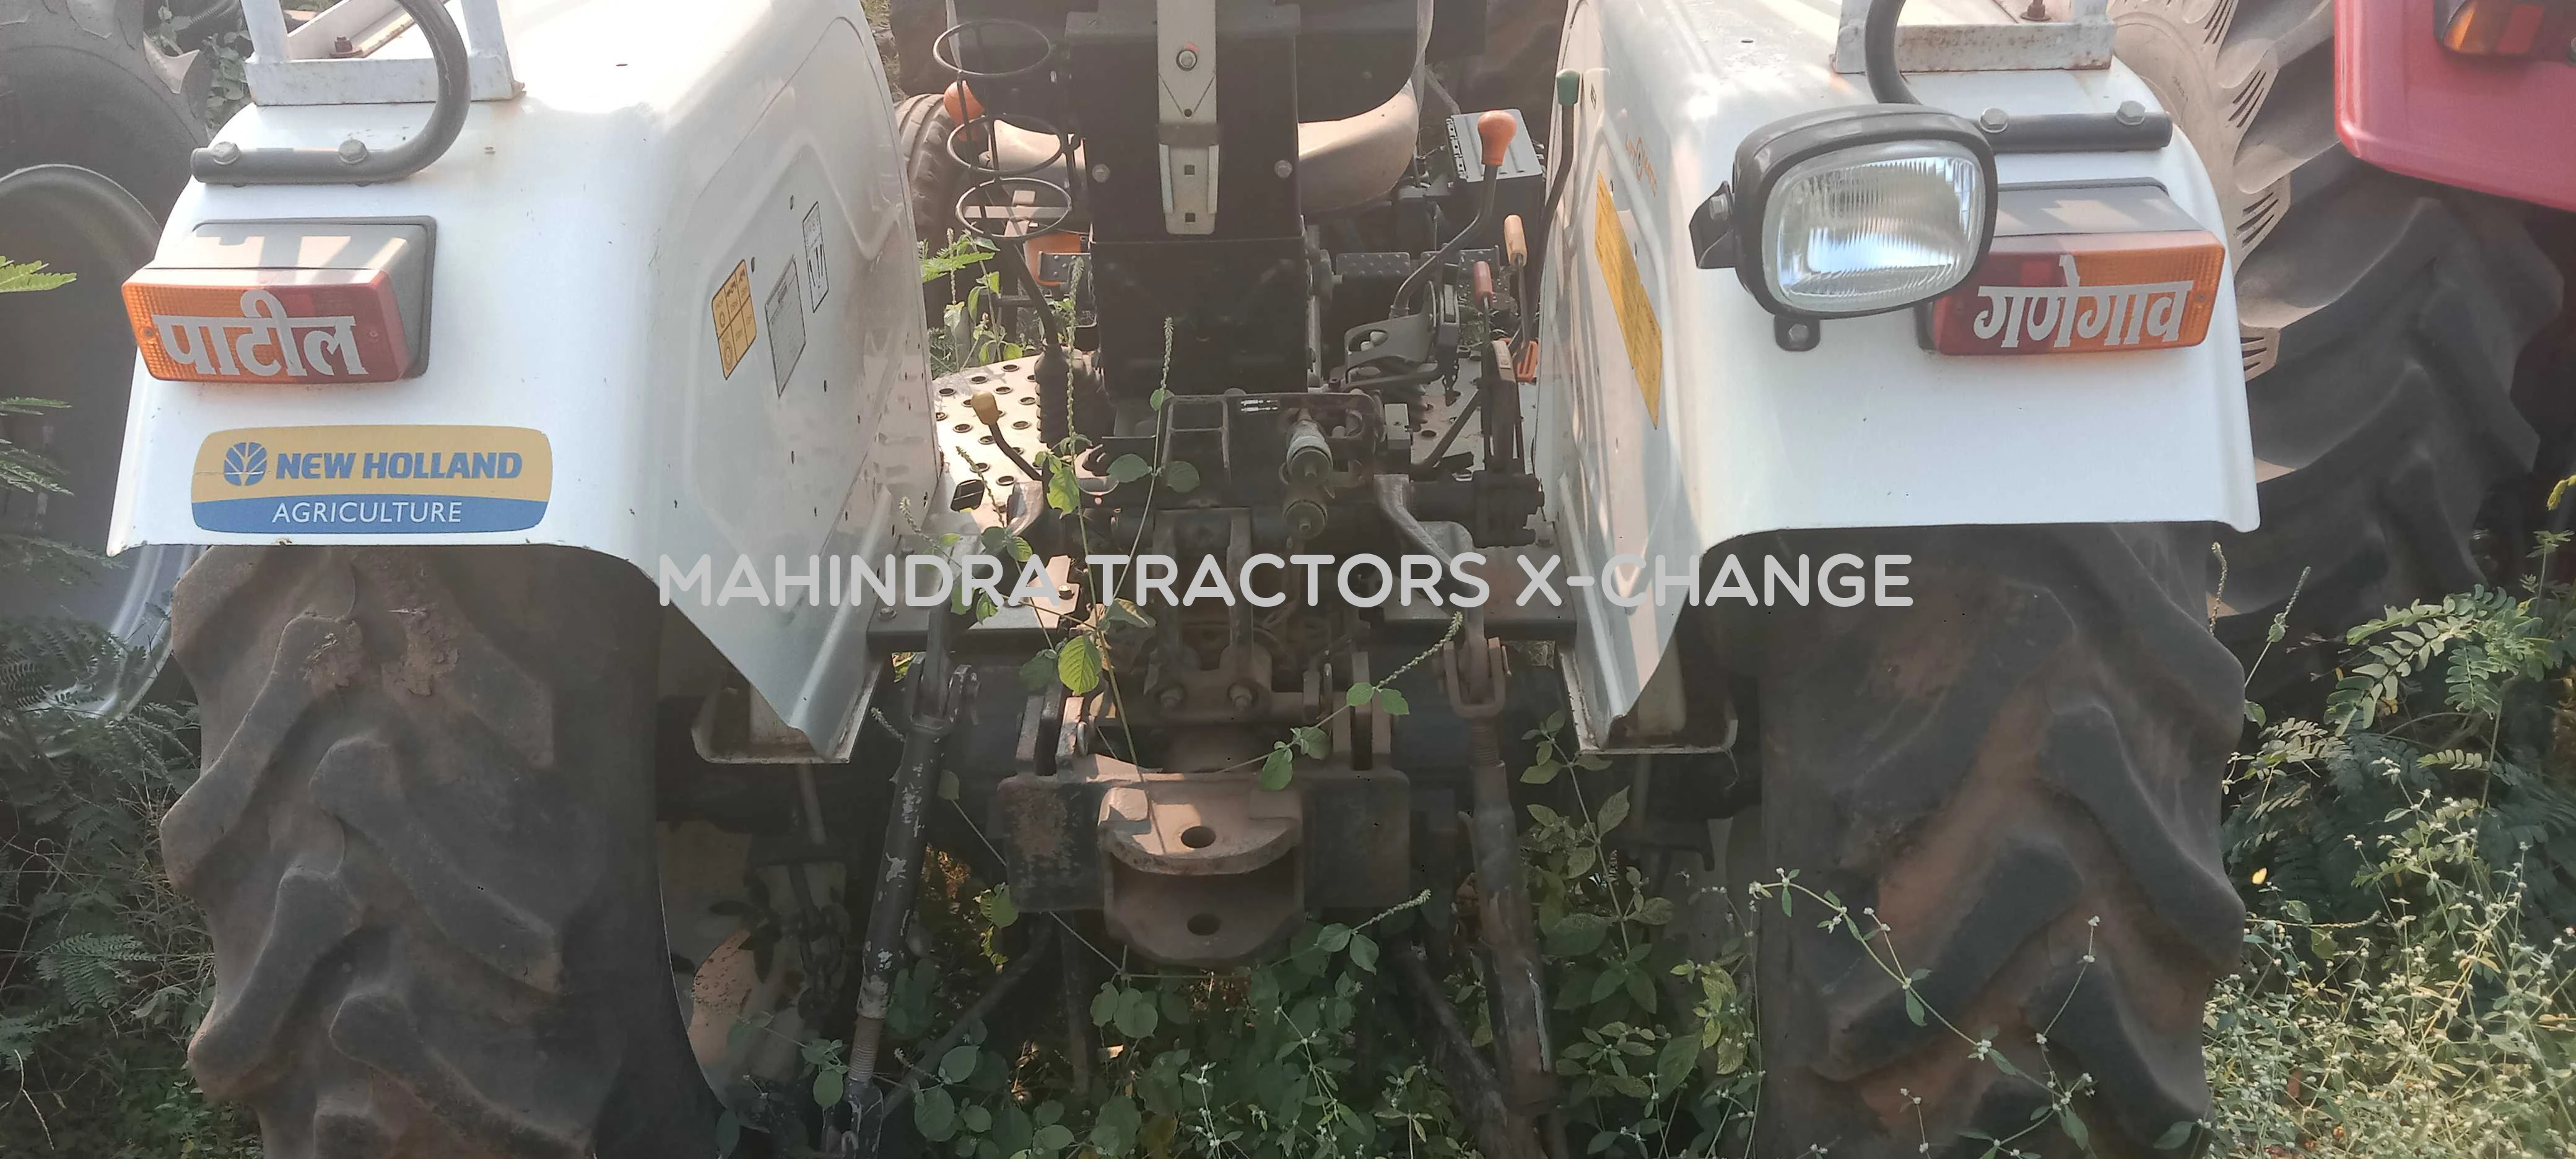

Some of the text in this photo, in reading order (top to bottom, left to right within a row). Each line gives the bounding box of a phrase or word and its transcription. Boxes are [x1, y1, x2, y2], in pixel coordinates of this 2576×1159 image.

[1973, 254, 2193, 349] गणेगाव
[152, 289, 368, 377] पाटील
[276, 452, 523, 479] NEW HOLLAND
[272, 501, 462, 524] AGRICULTURE
